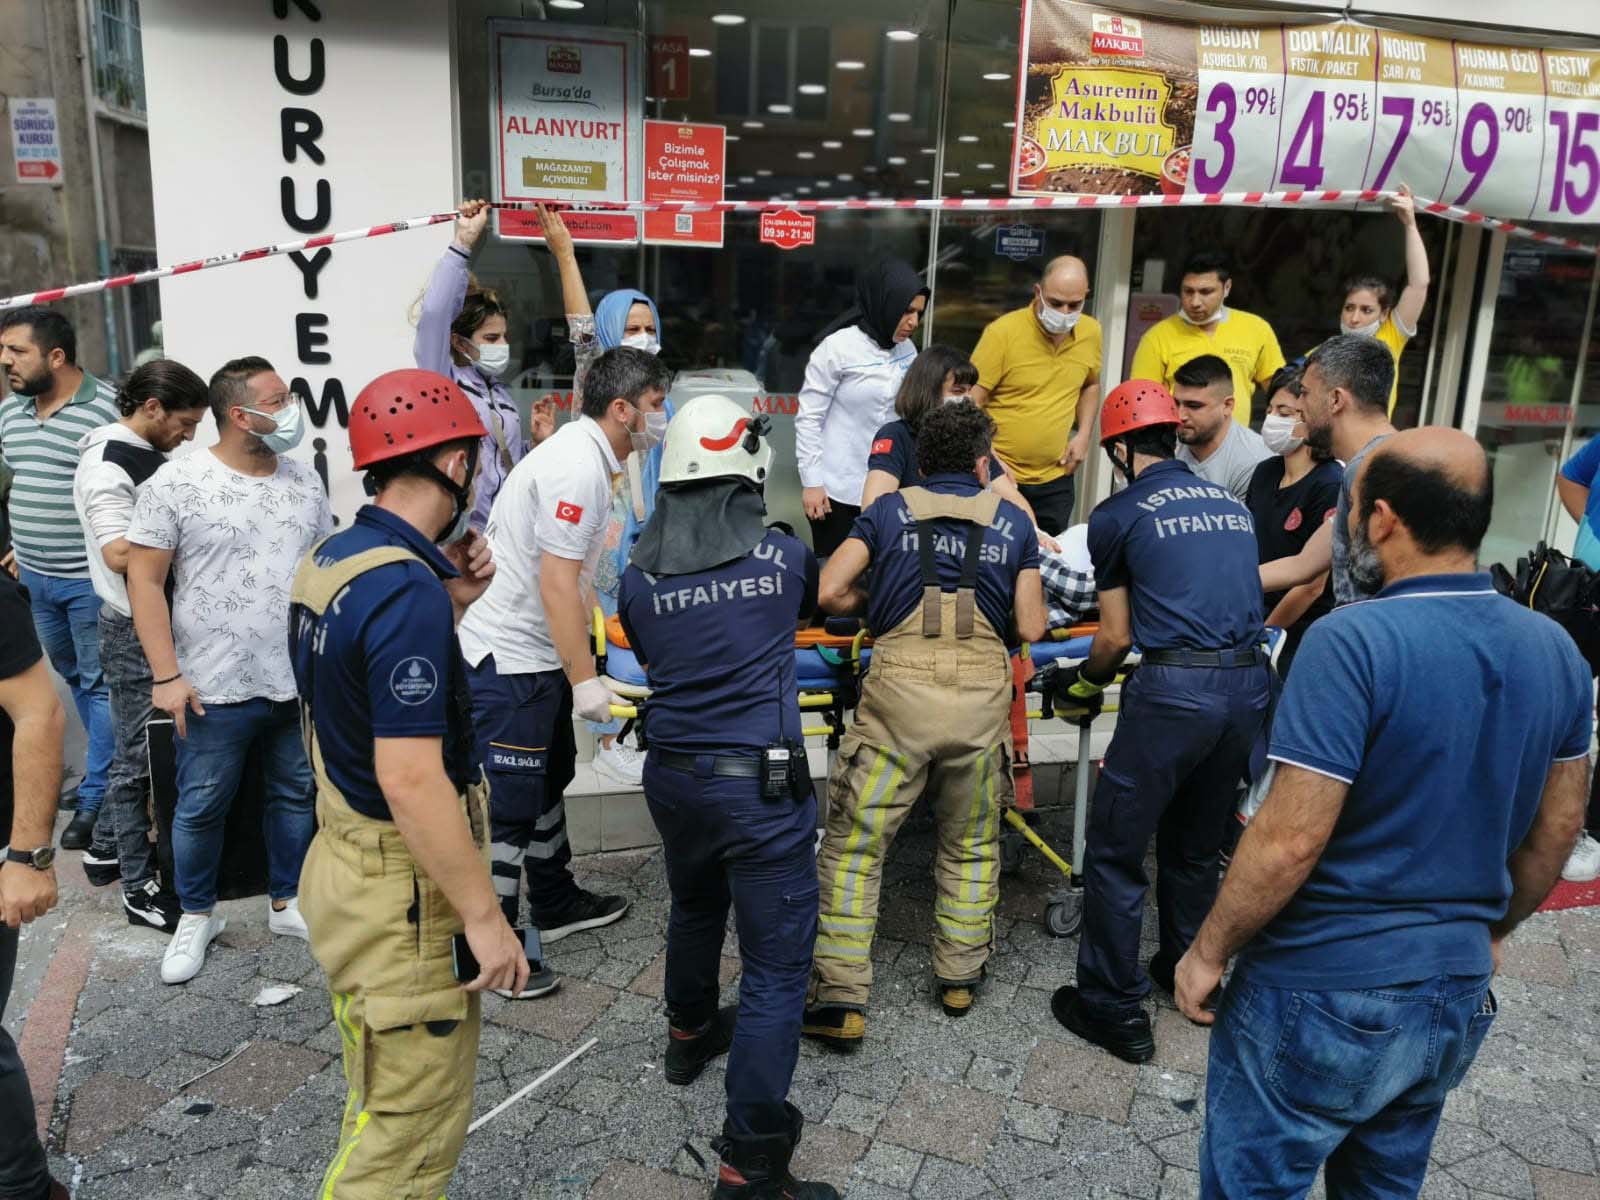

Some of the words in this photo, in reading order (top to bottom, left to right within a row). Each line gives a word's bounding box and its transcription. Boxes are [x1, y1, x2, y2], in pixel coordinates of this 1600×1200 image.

[1094, 37, 1142, 51] MAKBUL
[1200, 26, 1261, 50] BUĞDAY
[1289, 29, 1371, 57] DOLMALIK
[1383, 38, 1427, 62] NOHUT
[1459, 47, 1509, 72] HURMA
[1511, 50, 1538, 73] ÖZÜ
[1249, 57, 1267, 70] /KG
[1320, 61, 1359, 76] /PAKET
[1383, 65, 1405, 79] SARI
[1405, 66, 1422, 81] /KG
[1547, 55, 1590, 77] FISTIK
[532, 83, 592, 99] Bursa'da
[1065, 77, 1158, 100] Aşurenin
[1059, 100, 1157, 124] Makbulü
[506, 116, 621, 140] ALANYURT
[664, 143, 705, 156] Bizimle
[1046, 127, 1167, 158] MAKBUL
[535, 162, 592, 174] MAĞAZAMIZI
[659, 156, 709, 171] Çalışmak
[677, 173, 720, 184] misiniz?
[1154, 512, 1254, 538] İTFAİYESİ
[902, 530, 1008, 565] İTAİYESİ
[653, 572, 783, 615] İTFAİYESİ
